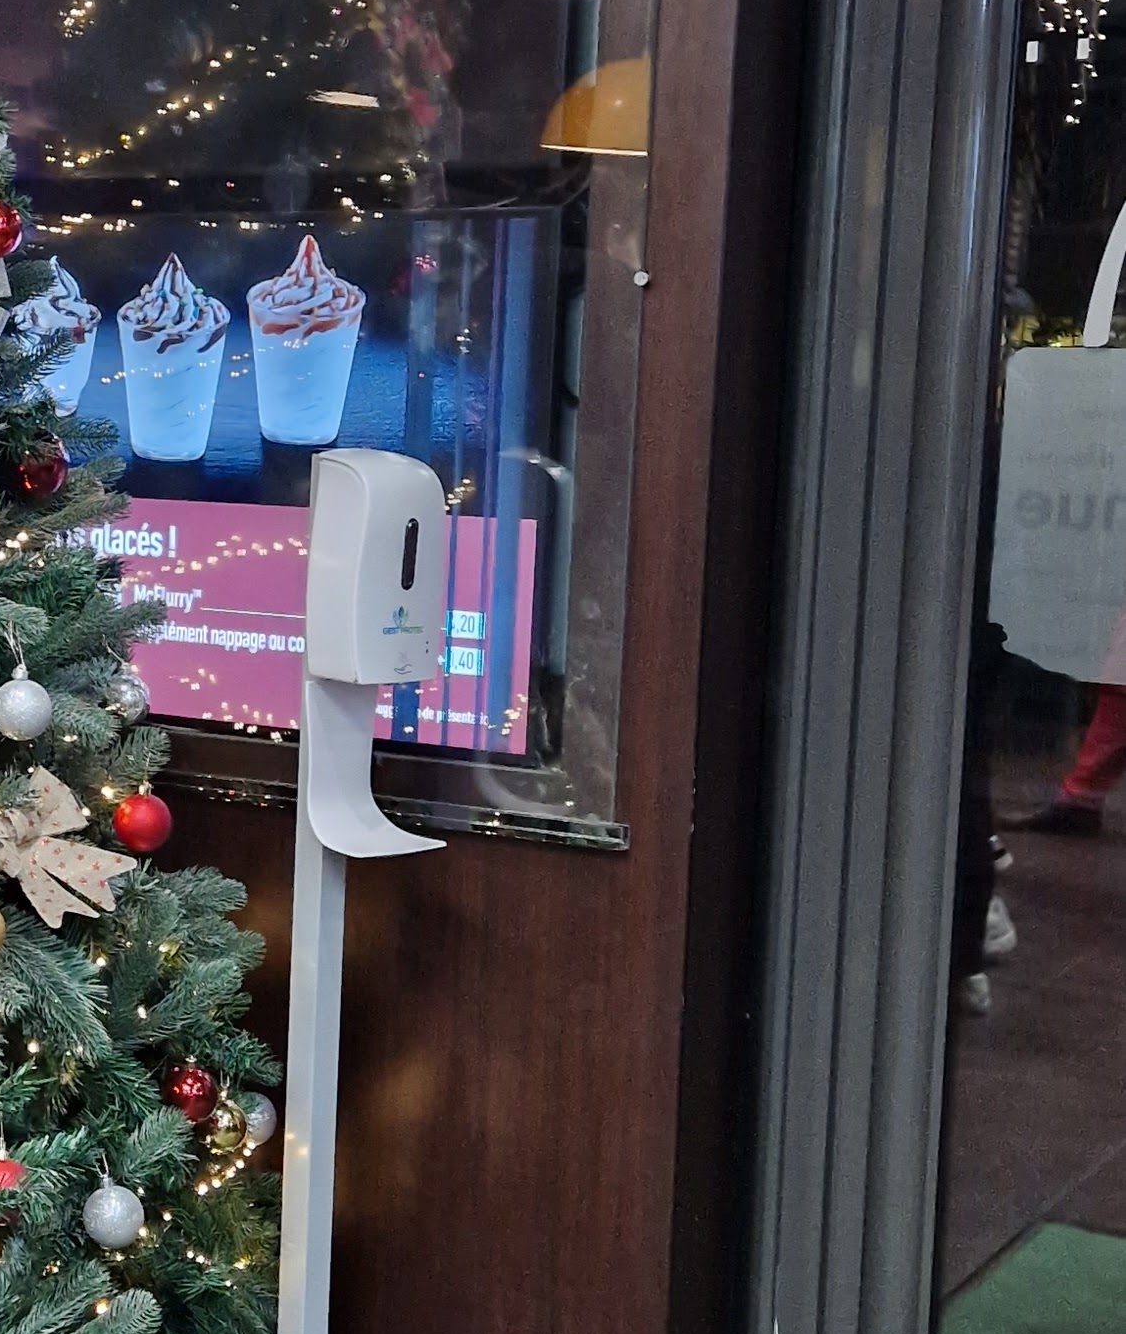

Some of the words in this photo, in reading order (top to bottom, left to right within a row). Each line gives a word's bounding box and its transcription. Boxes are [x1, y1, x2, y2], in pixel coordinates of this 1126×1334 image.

[90, 521, 163, 559] glacés
[168, 525, 176, 558] !
[452, 615, 475, 633] ,20
[210, 629, 266, 654] nappage
[268, 634, 285, 651] ou
